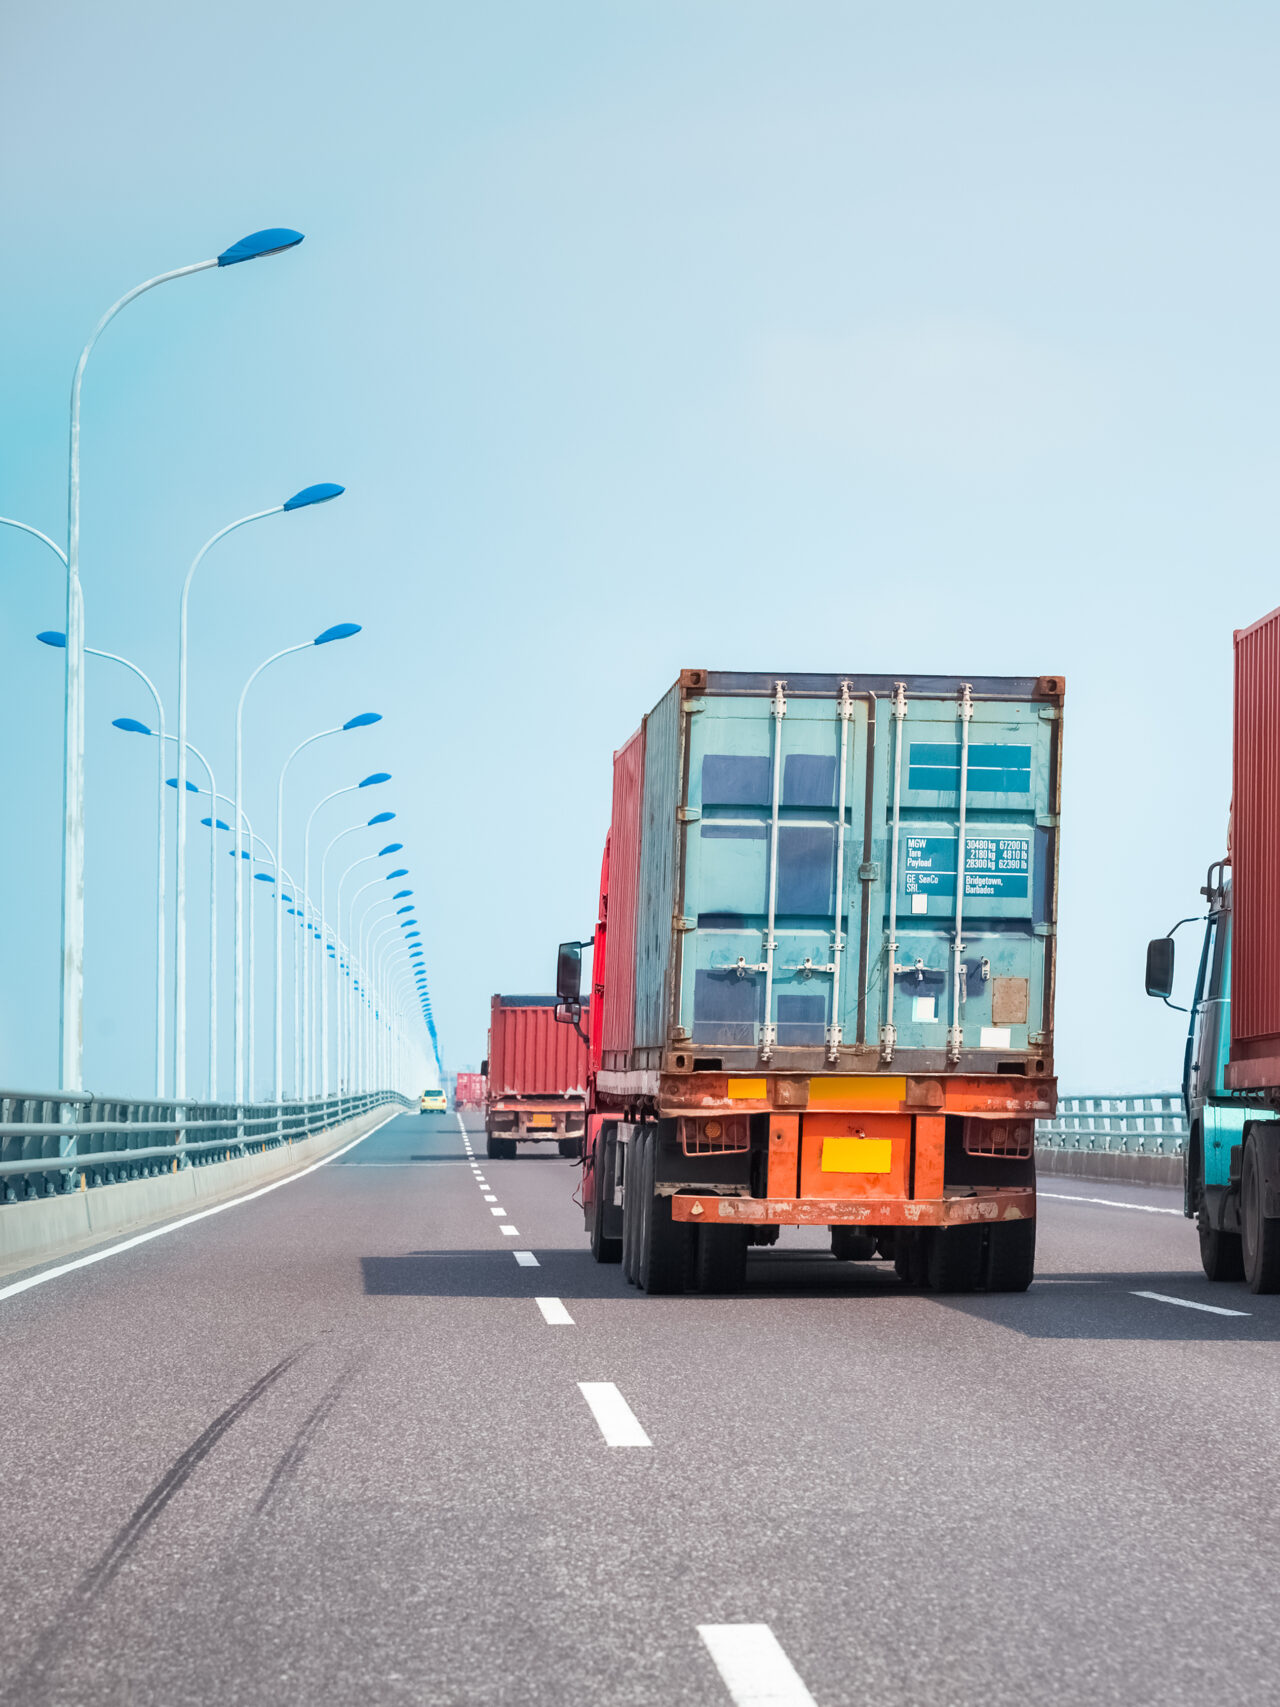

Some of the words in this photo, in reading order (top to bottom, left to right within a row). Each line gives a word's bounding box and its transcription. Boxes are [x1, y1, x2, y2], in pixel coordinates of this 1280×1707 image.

[907, 838, 927, 848] MGW
[966, 839, 988, 849] 30480
[988, 840, 996, 852] kg
[999, 840, 1021, 850] 67200
[1021, 841, 1028, 851] lb
[970, 849, 988, 859] 2180
[988, 850, 996, 861] kg
[1002, 850, 1021, 860] 4810
[1021, 850, 1028, 860] lb
[907, 857, 932, 869] Payload
[966, 859, 988, 869] 28300
[987, 859, 996, 871] kg
[998, 859, 1020, 870] 62390
[1020, 860, 1027, 870] lb
[906, 874, 916, 884] GE
[965, 884, 995, 895] Barbados
